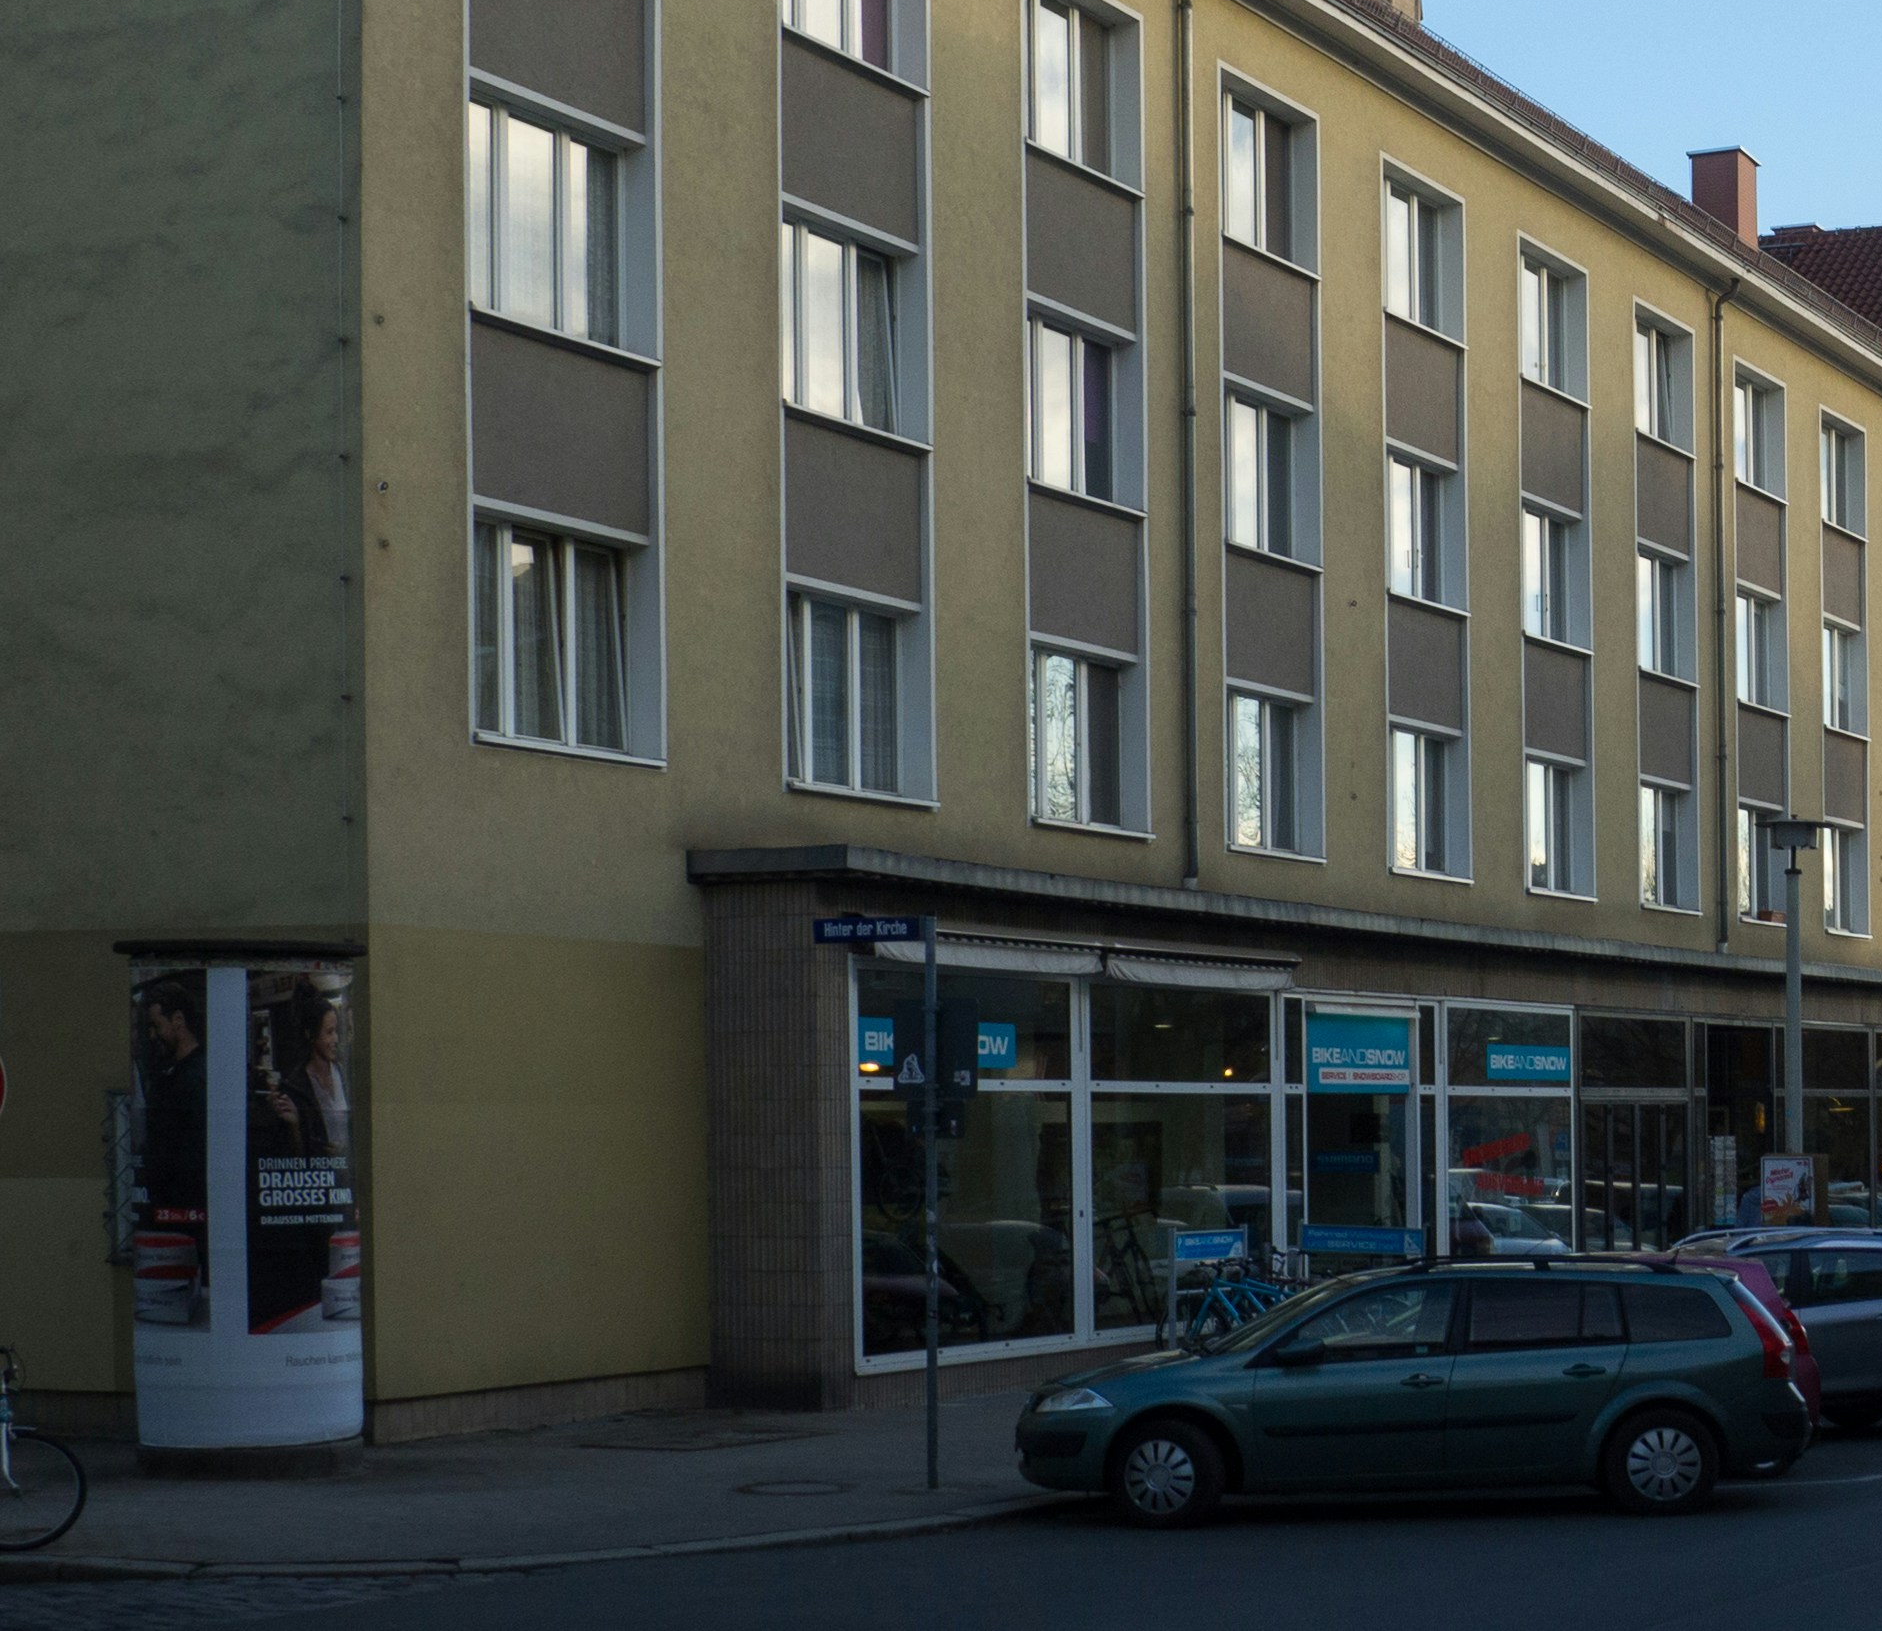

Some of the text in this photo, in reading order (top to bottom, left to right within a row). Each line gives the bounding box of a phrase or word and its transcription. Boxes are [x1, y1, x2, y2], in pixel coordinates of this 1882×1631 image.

[823, 920, 908, 937] Hinter der Kirche
[1312, 1047, 1406, 1066] BIKEANDSNOW
[1490, 1054, 1567, 1071] BIKEANDSNOW
[258, 1156, 307, 1170] DRINNEN
[259, 1170, 335, 1188] DRAUSSEN
[260, 1189, 326, 1206] GROSSES
[285, 1353, 327, 1367] Rauchen
